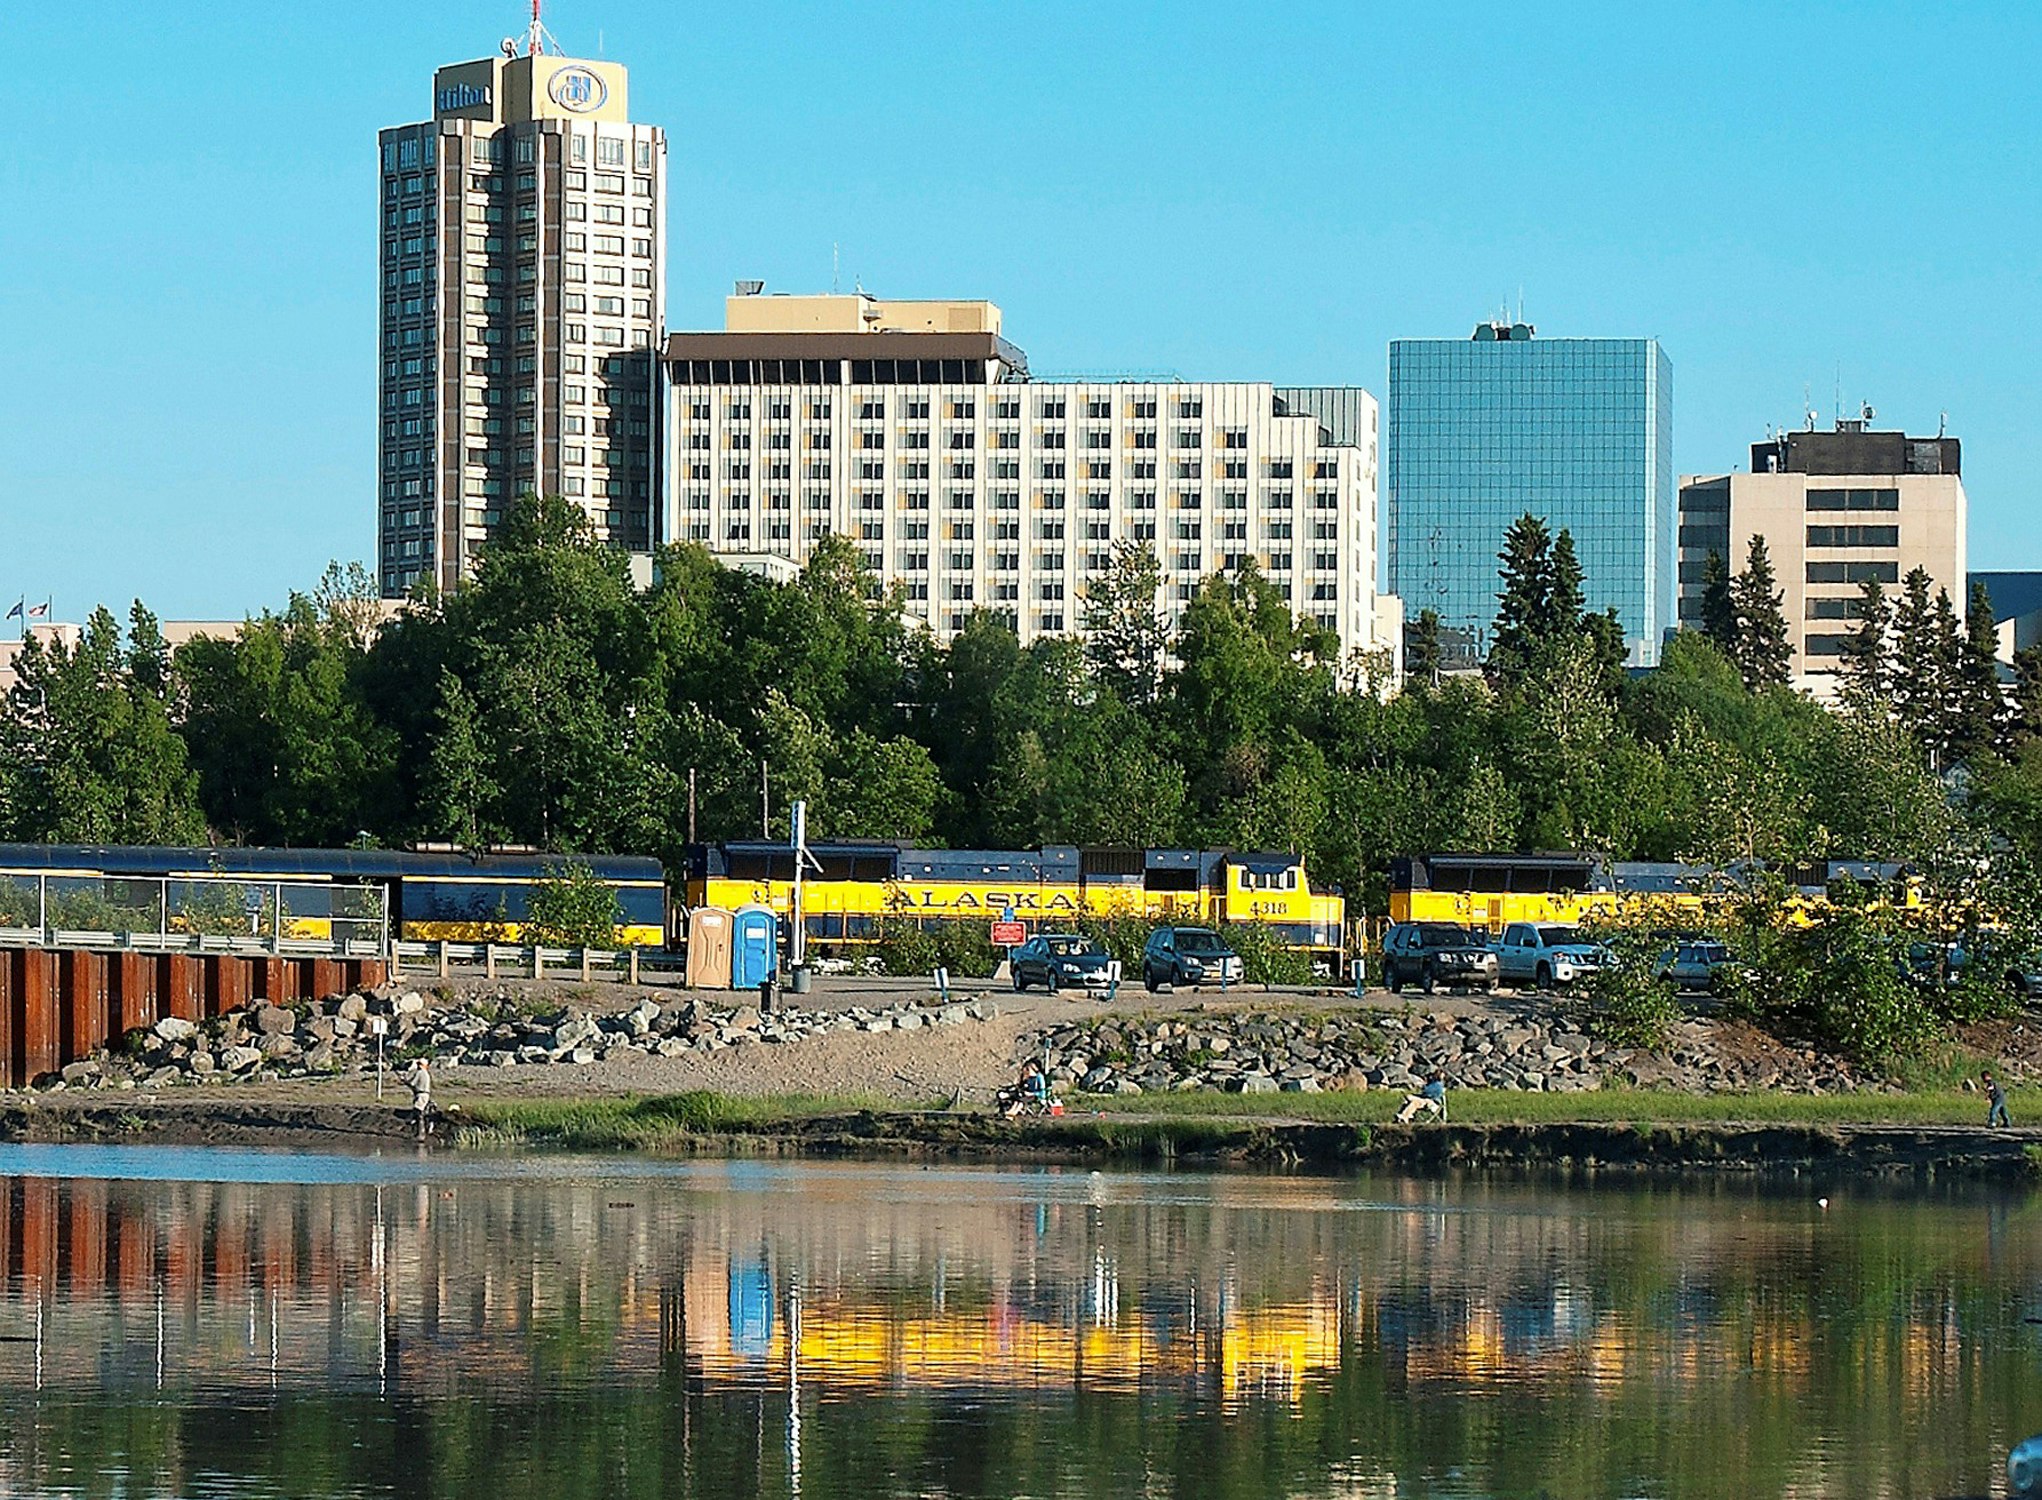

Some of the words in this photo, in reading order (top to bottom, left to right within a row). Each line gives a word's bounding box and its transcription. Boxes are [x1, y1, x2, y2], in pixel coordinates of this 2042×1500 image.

[440, 83, 491, 111] Hilton
[889, 891, 1076, 910] ALASKA
[1250, 901, 1287, 916] 4318
